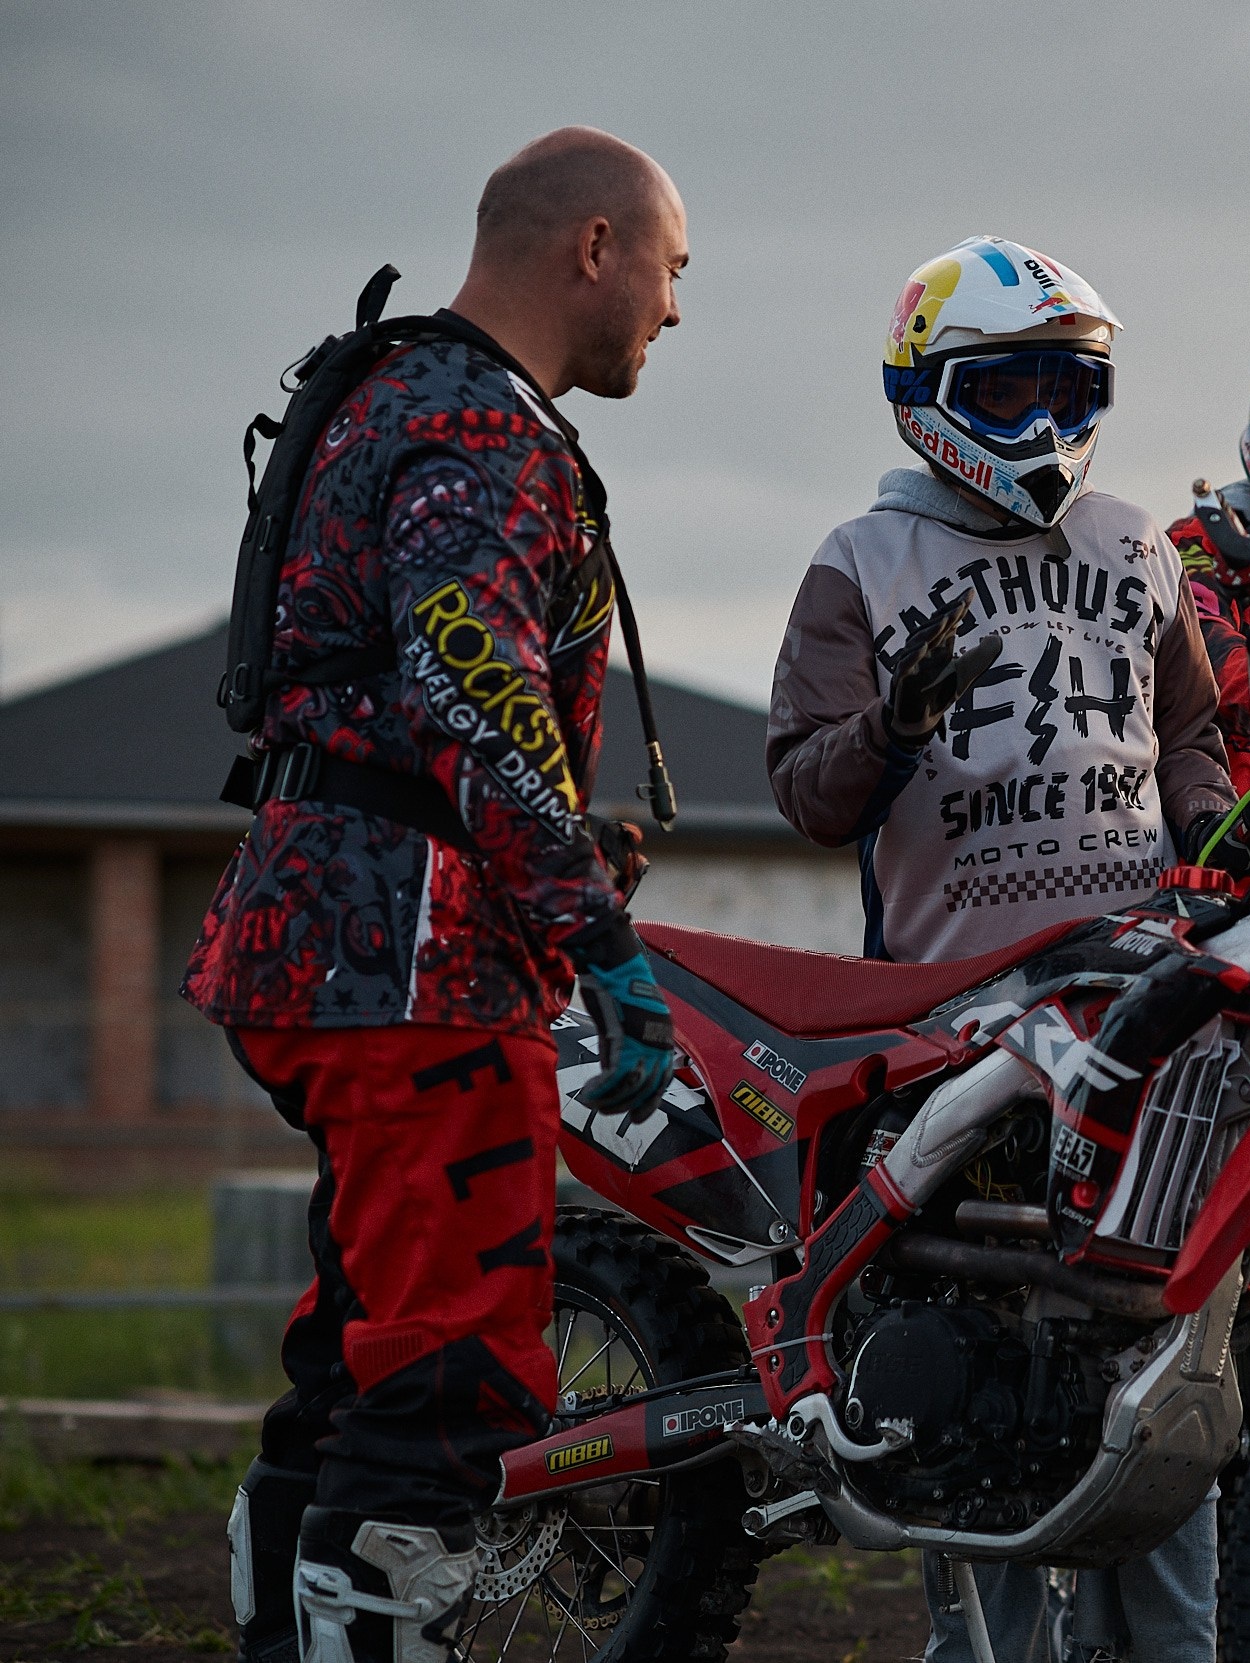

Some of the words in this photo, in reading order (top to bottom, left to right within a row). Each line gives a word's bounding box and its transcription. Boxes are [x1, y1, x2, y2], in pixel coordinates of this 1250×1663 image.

[900, 404, 939, 456] Red
[942, 441, 993, 491] Bull
[1047, 620, 1075, 635] LET
[1083, 631, 1126, 654] LIVE
[404, 634, 500, 746] ENERGY
[496, 749, 584, 838] DRINK
[940, 771, 1070, 841] SINCE
[953, 838, 1061, 871] MOTO
[1078, 828, 1159, 852] CREW
[238, 906, 289, 954] FLY
[757, 1045, 807, 1093] IPONE
[732, 1085, 796, 1137] NIBBI
[412, 1038, 548, 1273] FLY
[680, 1398, 745, 1432] IPONE
[549, 1437, 612, 1470] NIBBI
